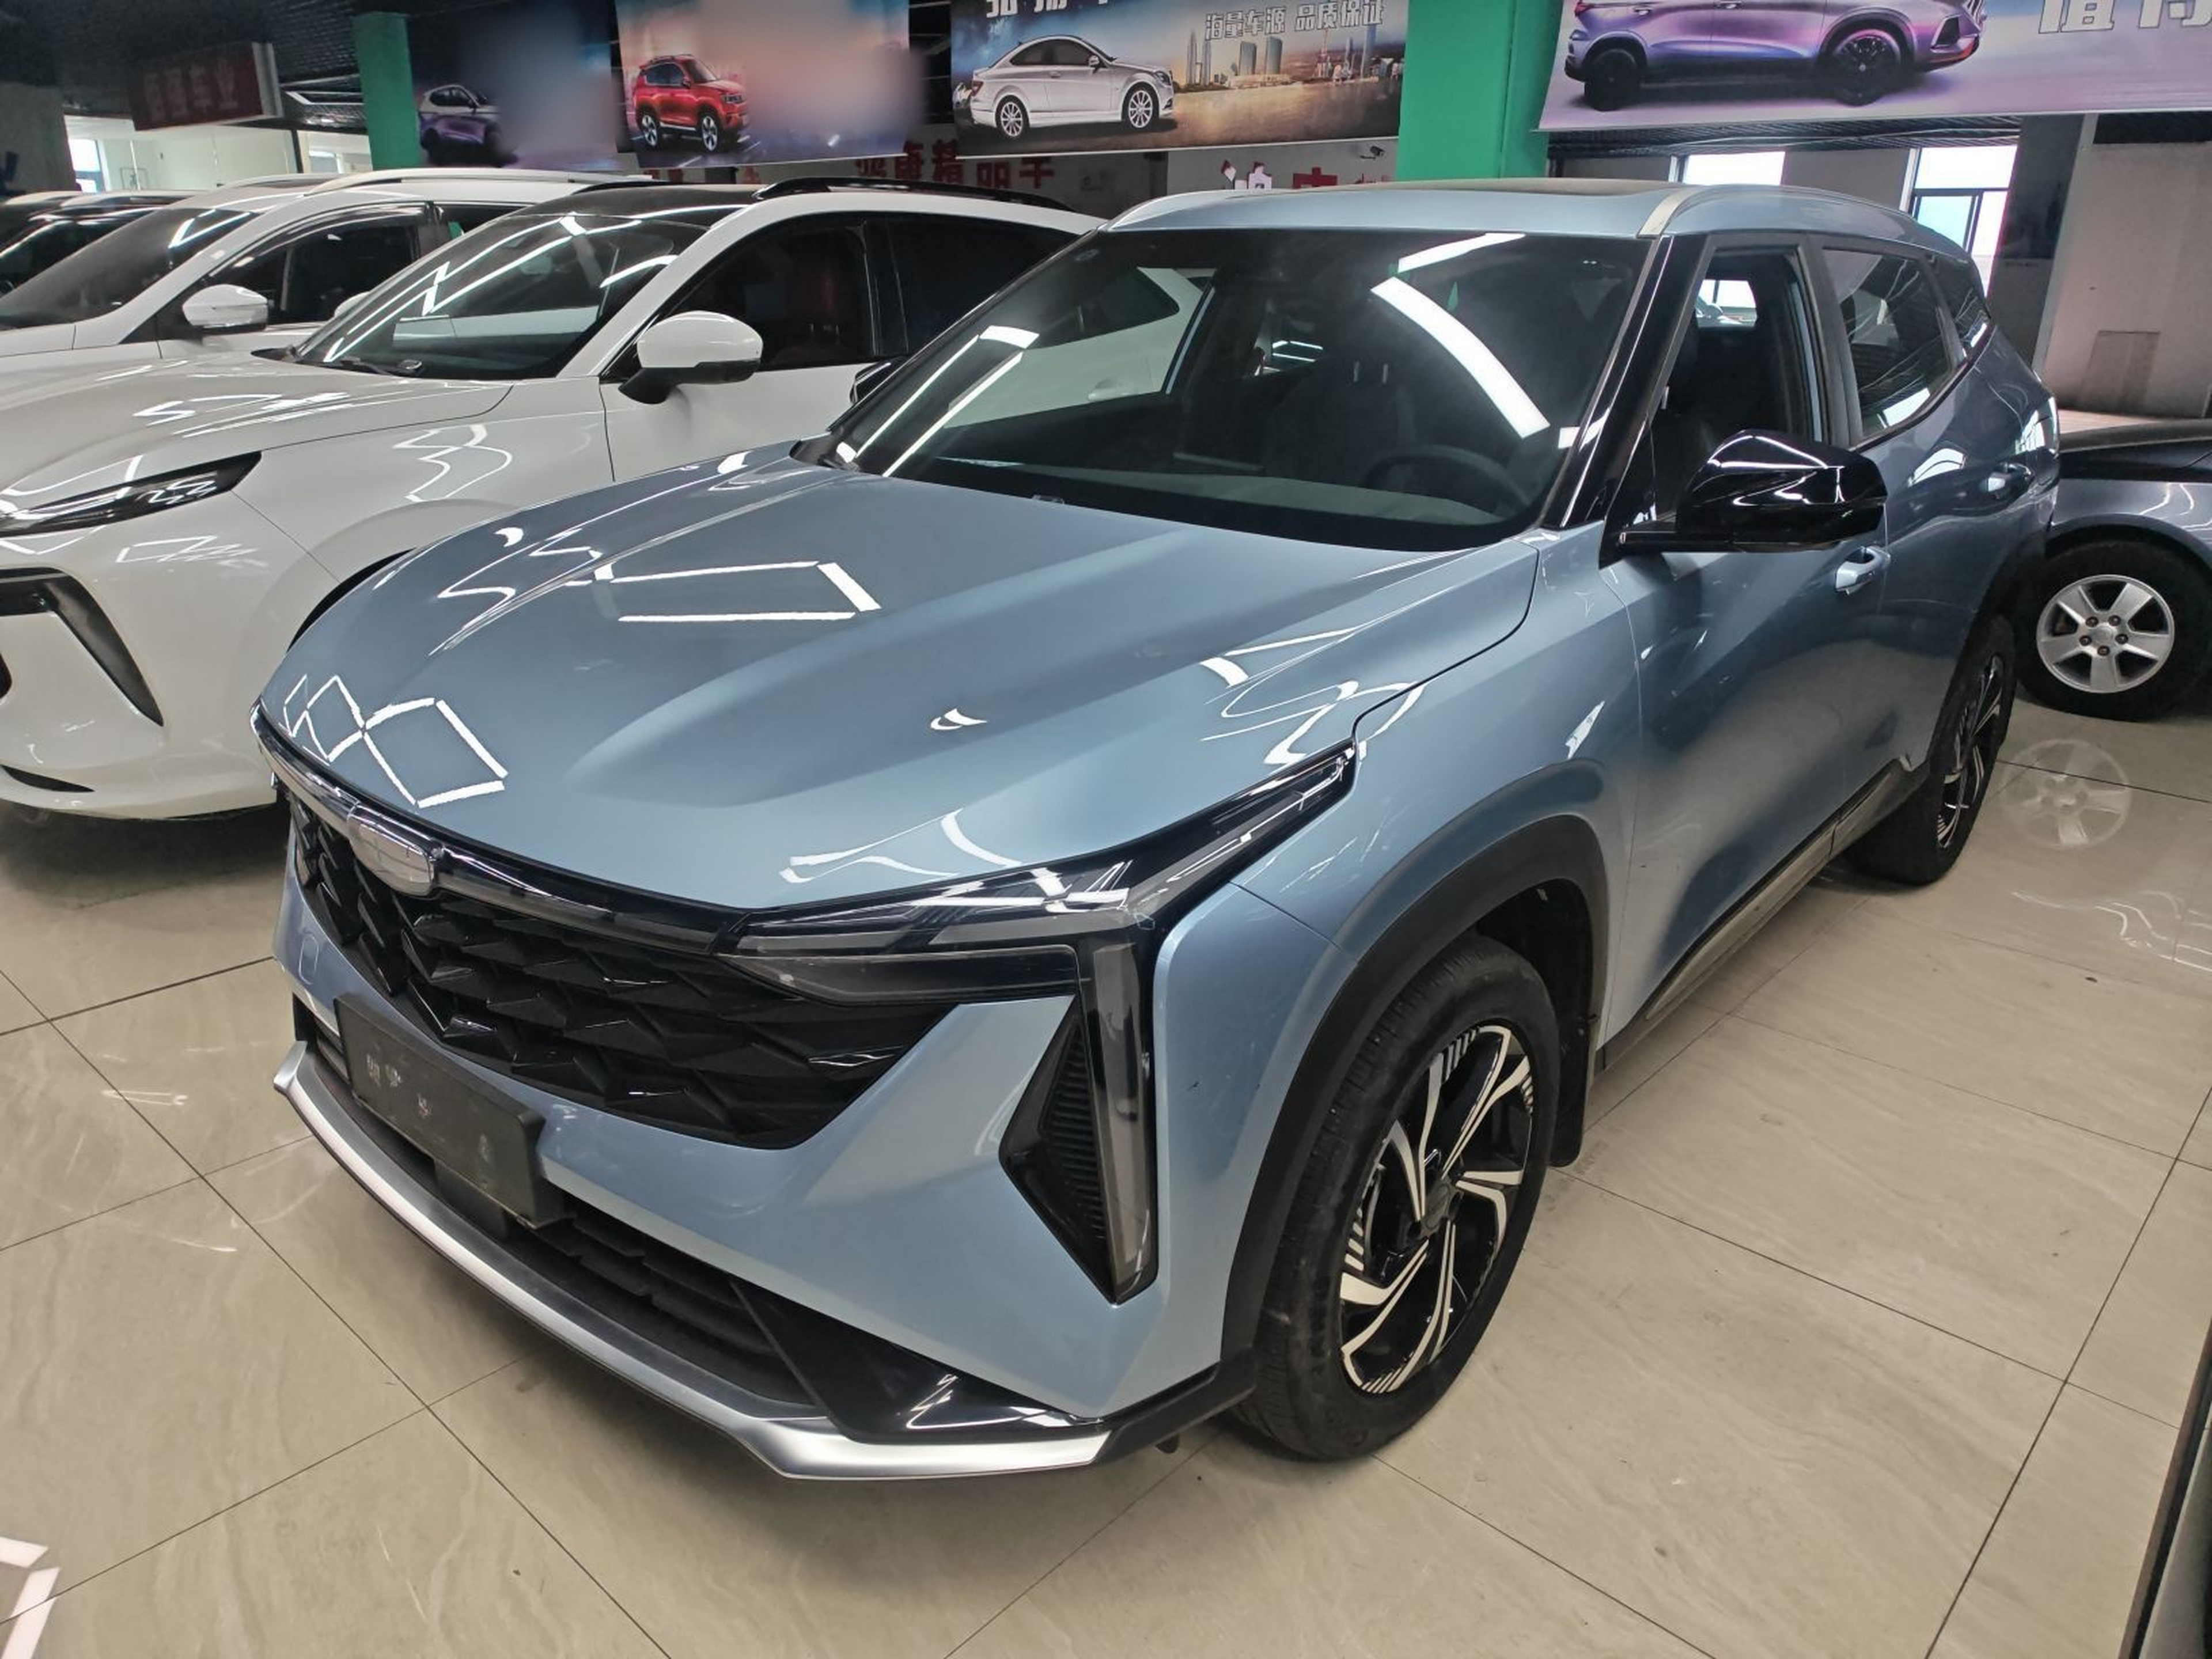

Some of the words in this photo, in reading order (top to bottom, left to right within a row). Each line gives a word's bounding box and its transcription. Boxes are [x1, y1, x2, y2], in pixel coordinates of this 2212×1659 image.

[1205, 6, 1286, 40] 海量车源
[1294, 0, 1383, 32] 品质保证
